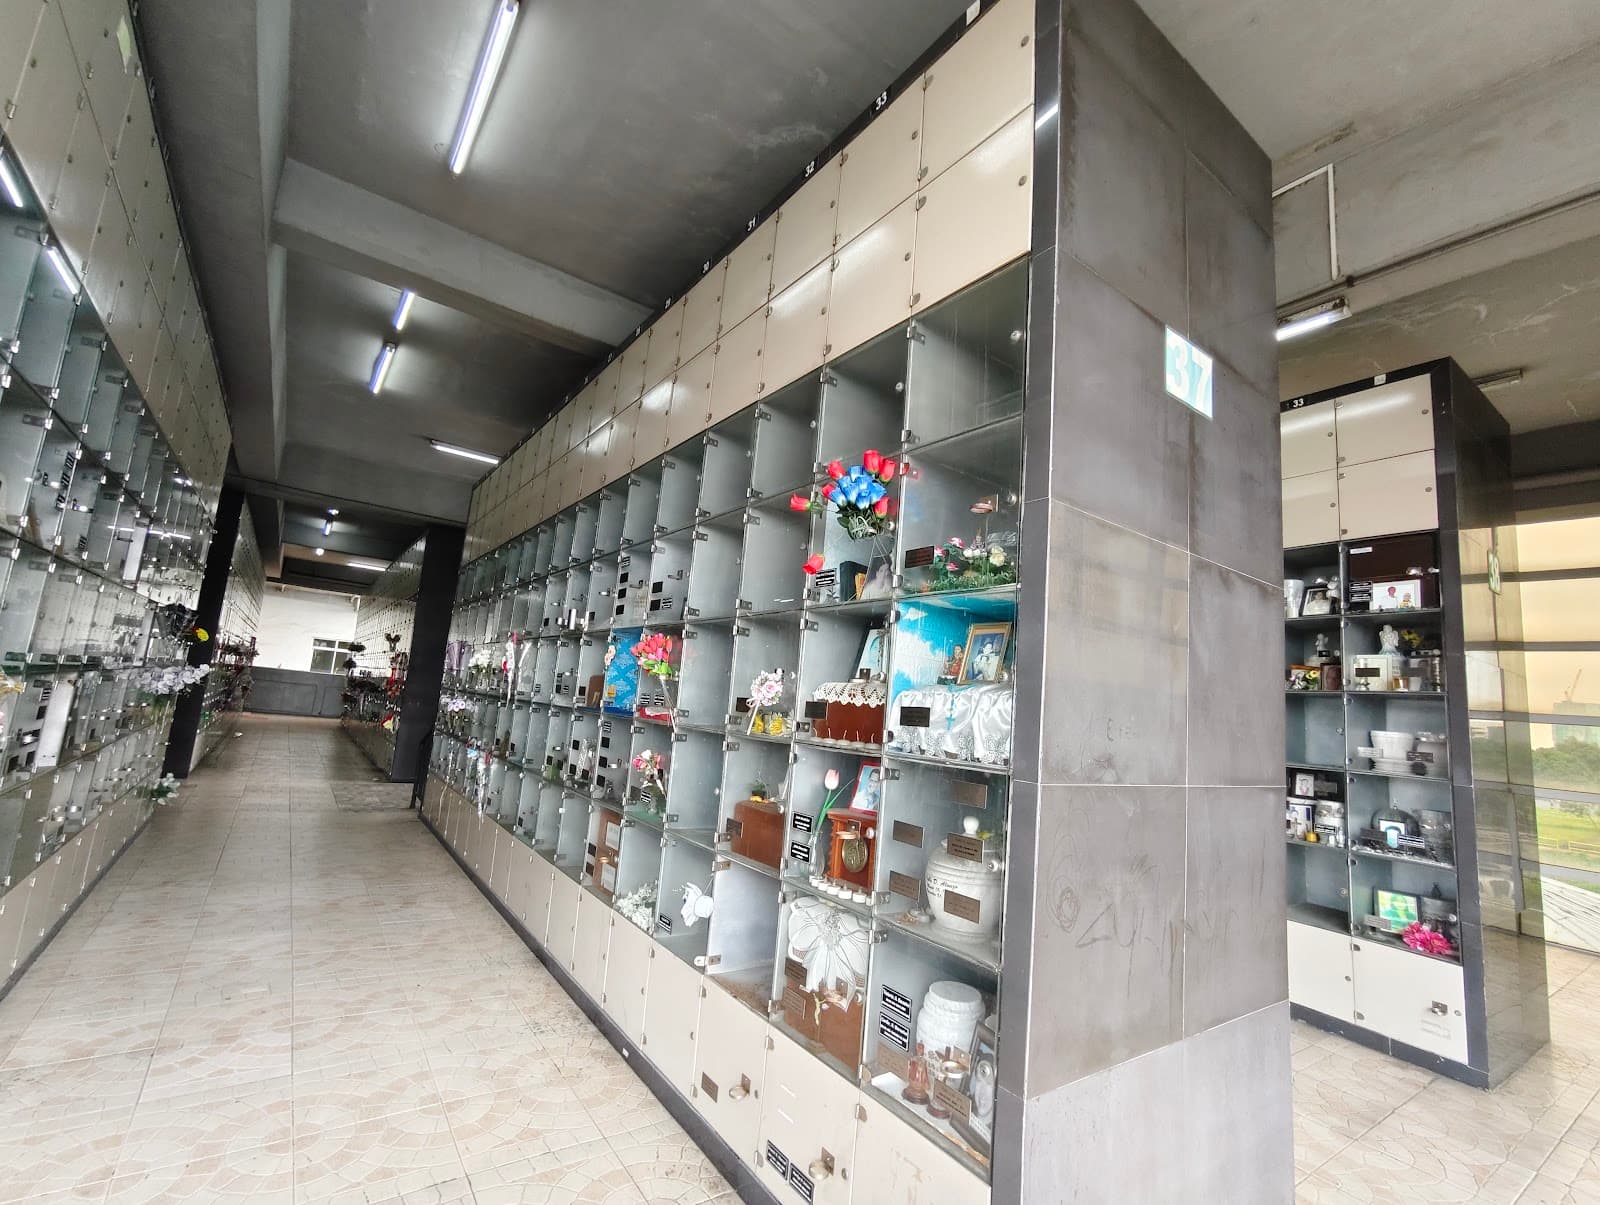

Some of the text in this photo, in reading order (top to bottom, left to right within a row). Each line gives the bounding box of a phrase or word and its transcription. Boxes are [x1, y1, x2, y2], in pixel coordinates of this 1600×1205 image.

[875, 91, 887, 110] 33
[804, 160, 815, 177] 32
[1166, 329, 1212, 418] 37
[1292, 398, 1304, 408] 33
[1488, 553, 1501, 592] 38
